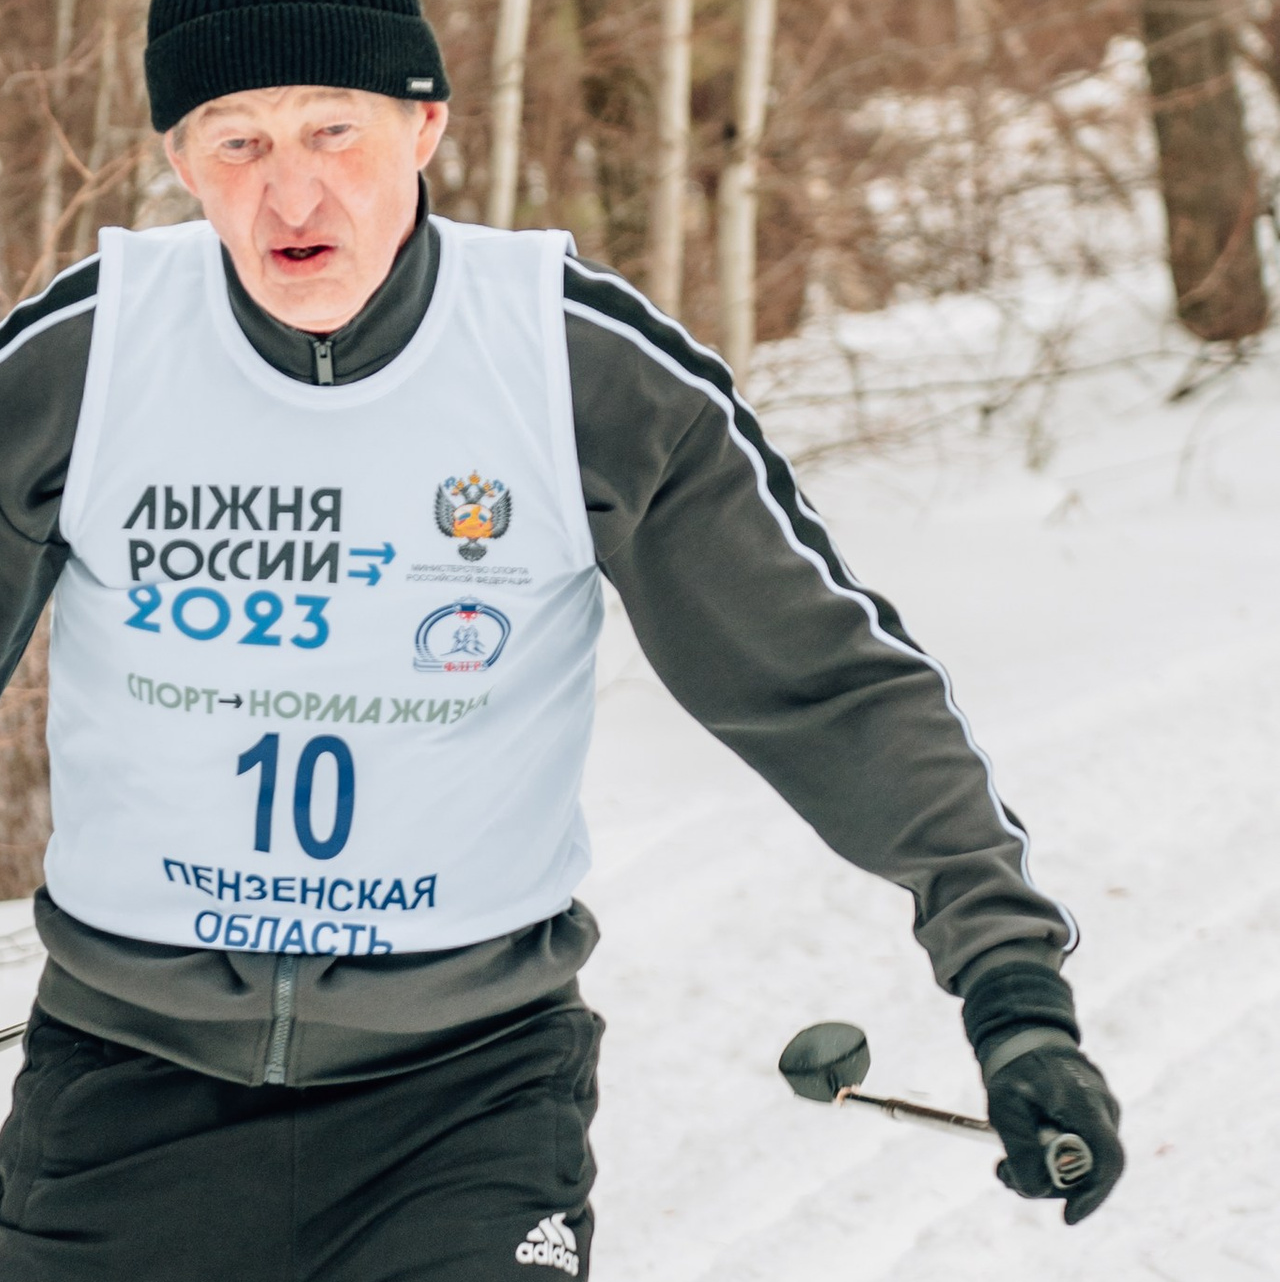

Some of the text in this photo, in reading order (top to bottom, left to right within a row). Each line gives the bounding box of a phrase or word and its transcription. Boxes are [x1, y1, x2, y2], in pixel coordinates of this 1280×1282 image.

[122, 485, 343, 532] ЛЫЖНЯ
[128, 538, 340, 584] РОССИИ
[406, 573, 532, 585] РОССИЙСКОЙ ФЕДЕРАЦИИ
[411, 564, 529, 575] МИНИСТЕРСТВО СПОРТА
[123, 585, 332, 649] 2023
[127, 672, 219, 715] СПОРТ
[249, 689, 383, 724] НОРМА
[236, 732, 356, 860] 10
[163, 856, 439, 912] ПЕНЗЕНСКАЯ
[194, 909, 394, 956] ОБЛАСТЬ
[516, 1240, 579, 1276] adidas
